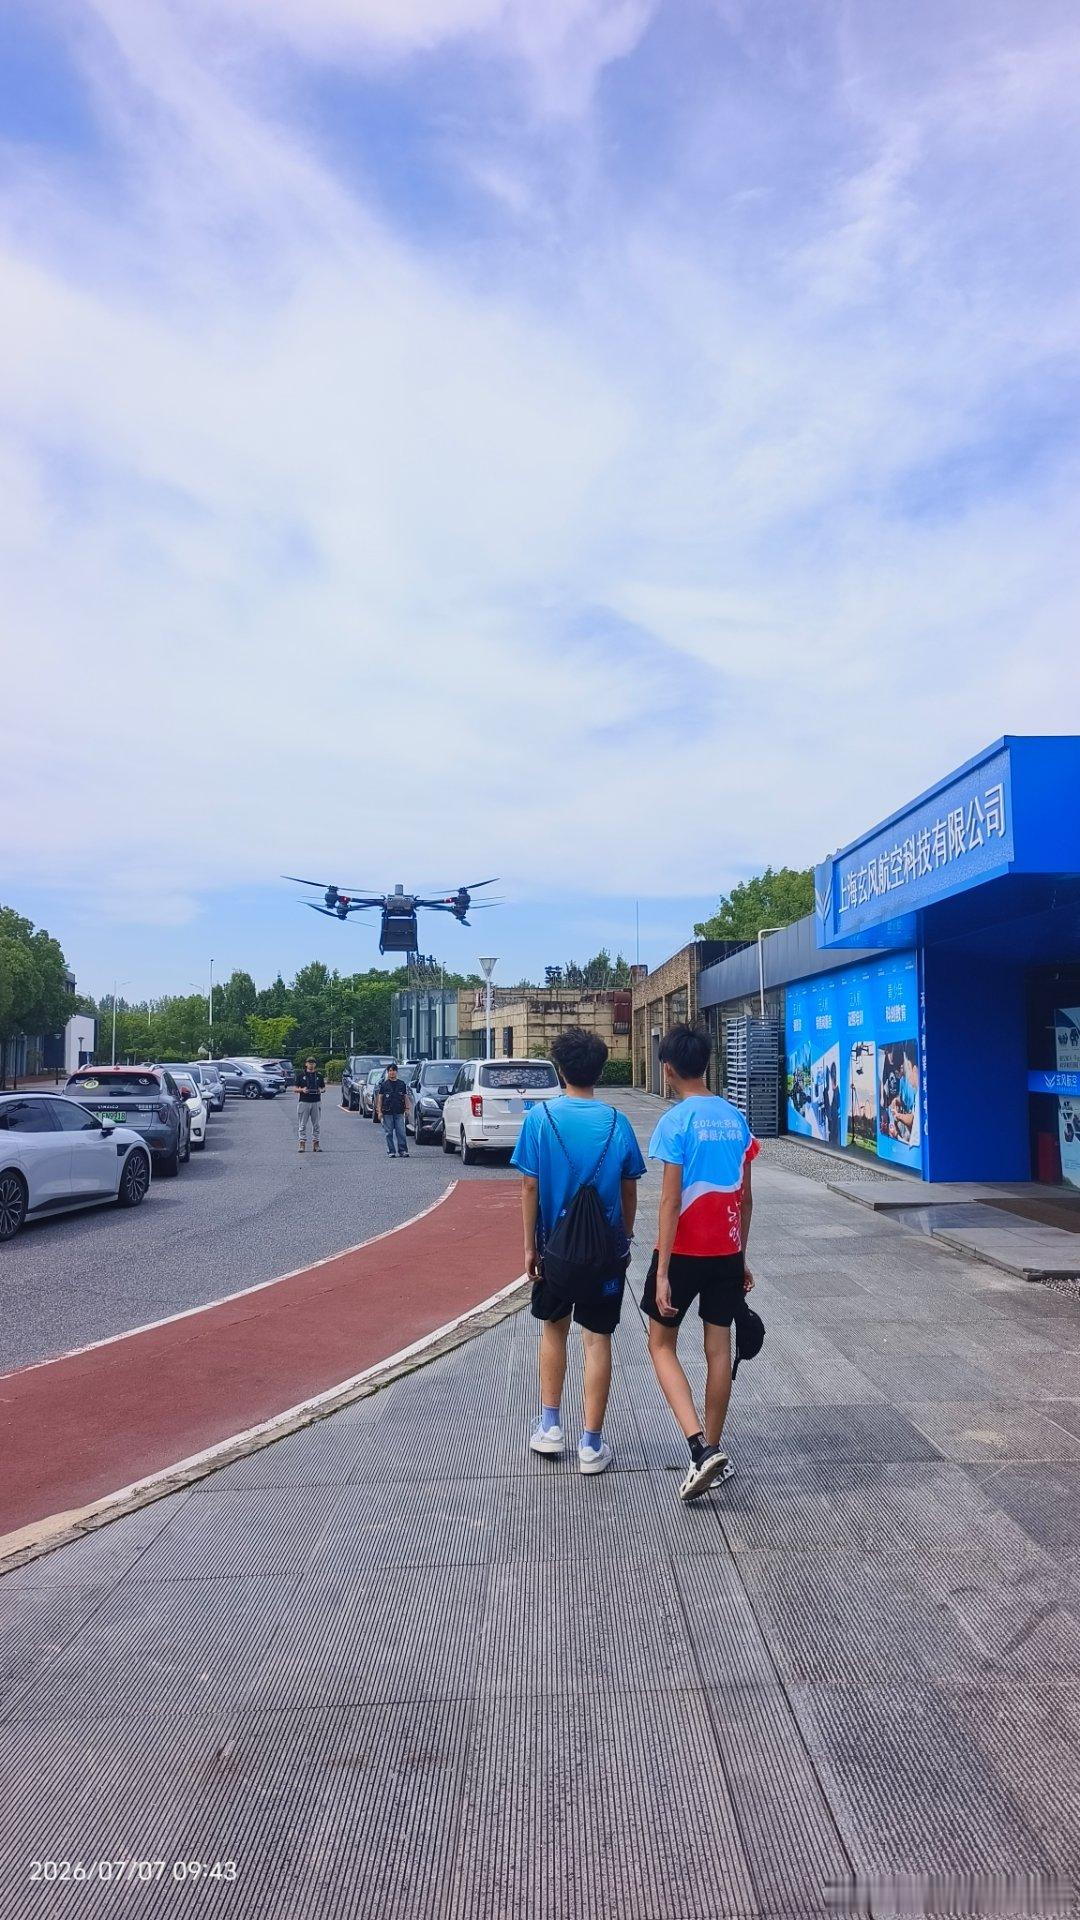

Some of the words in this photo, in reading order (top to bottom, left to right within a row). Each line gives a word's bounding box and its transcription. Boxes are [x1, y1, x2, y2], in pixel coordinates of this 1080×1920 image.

[838, 782, 1006, 914] 上海玄风航空科技有限公司
